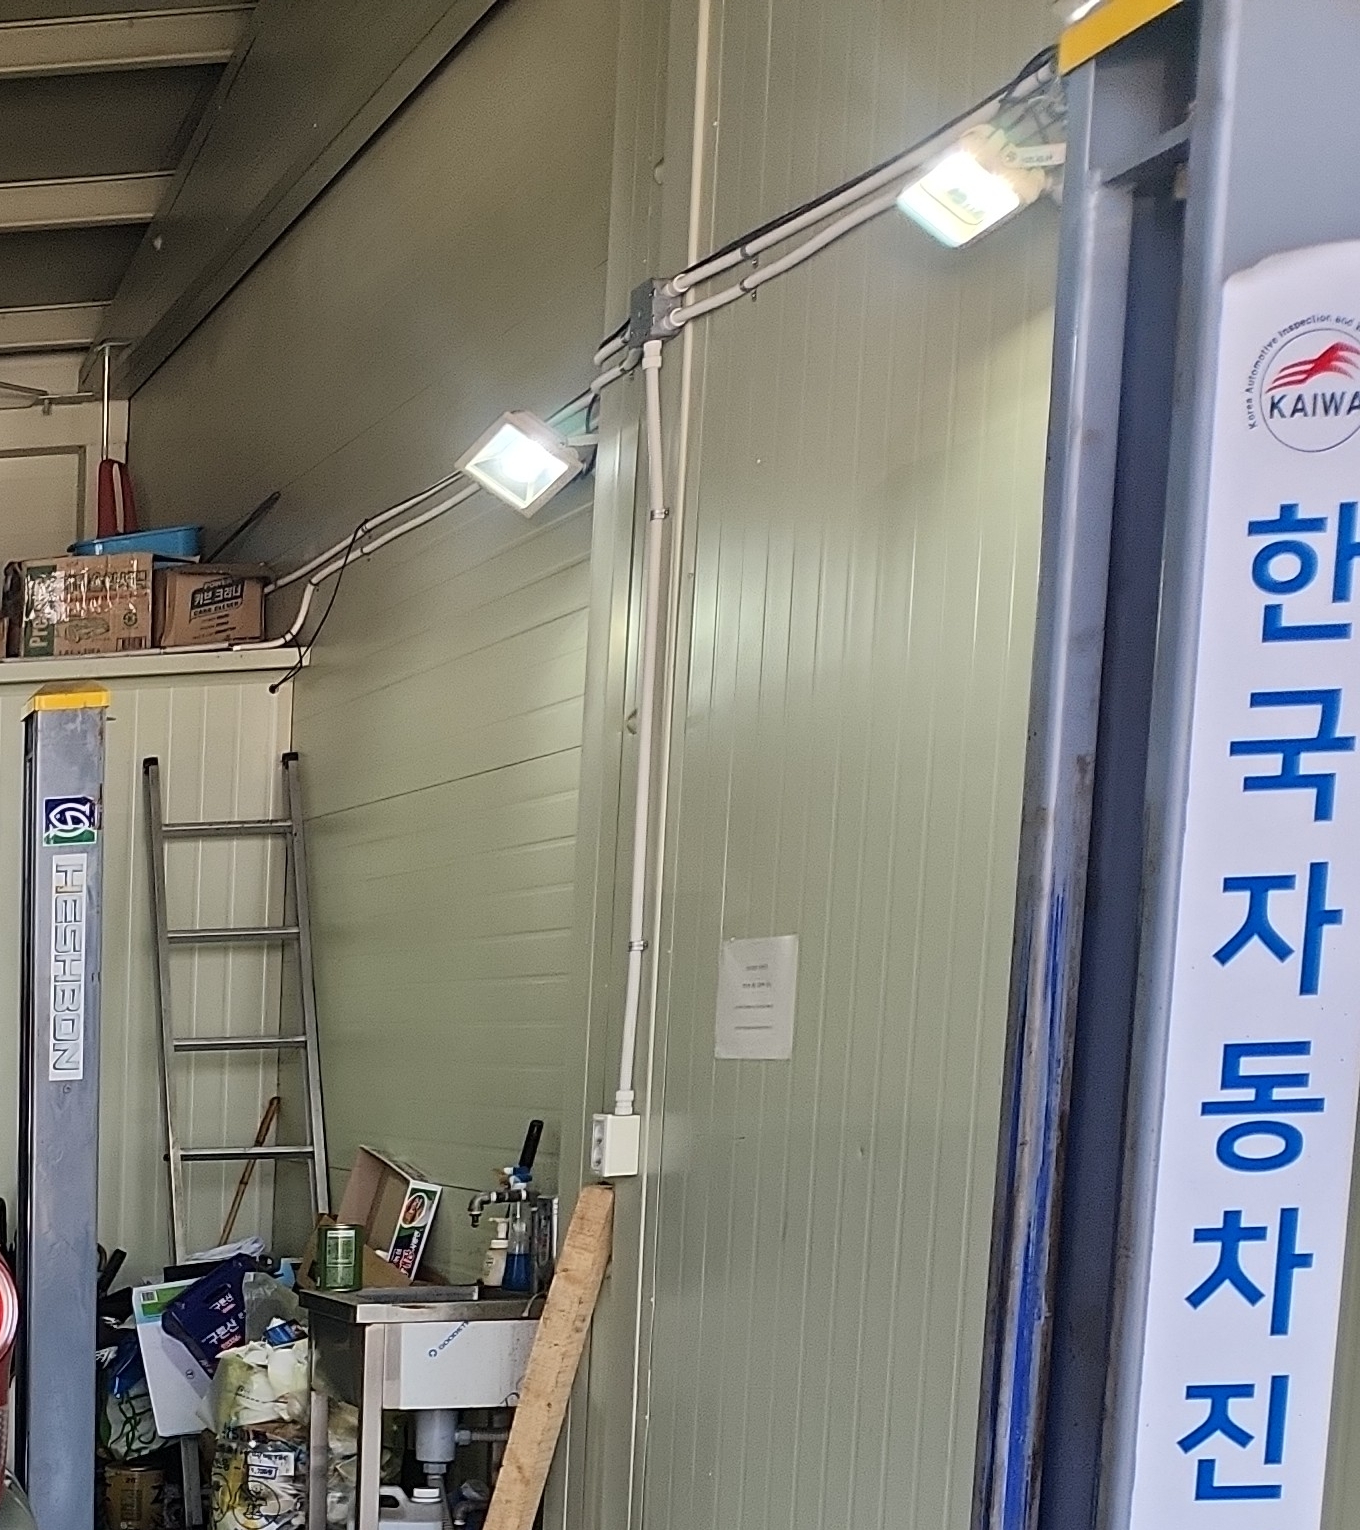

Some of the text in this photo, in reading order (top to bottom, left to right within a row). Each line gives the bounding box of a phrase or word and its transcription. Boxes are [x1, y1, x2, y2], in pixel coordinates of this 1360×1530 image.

[1245, 336, 1278, 393] Automotive
[1278, 314, 1332, 338] Inspection
[1335, 315, 1354, 327] and
[1269, 391, 1360, 420] KAIWA
[53, 863, 84, 1071] HESHBON
